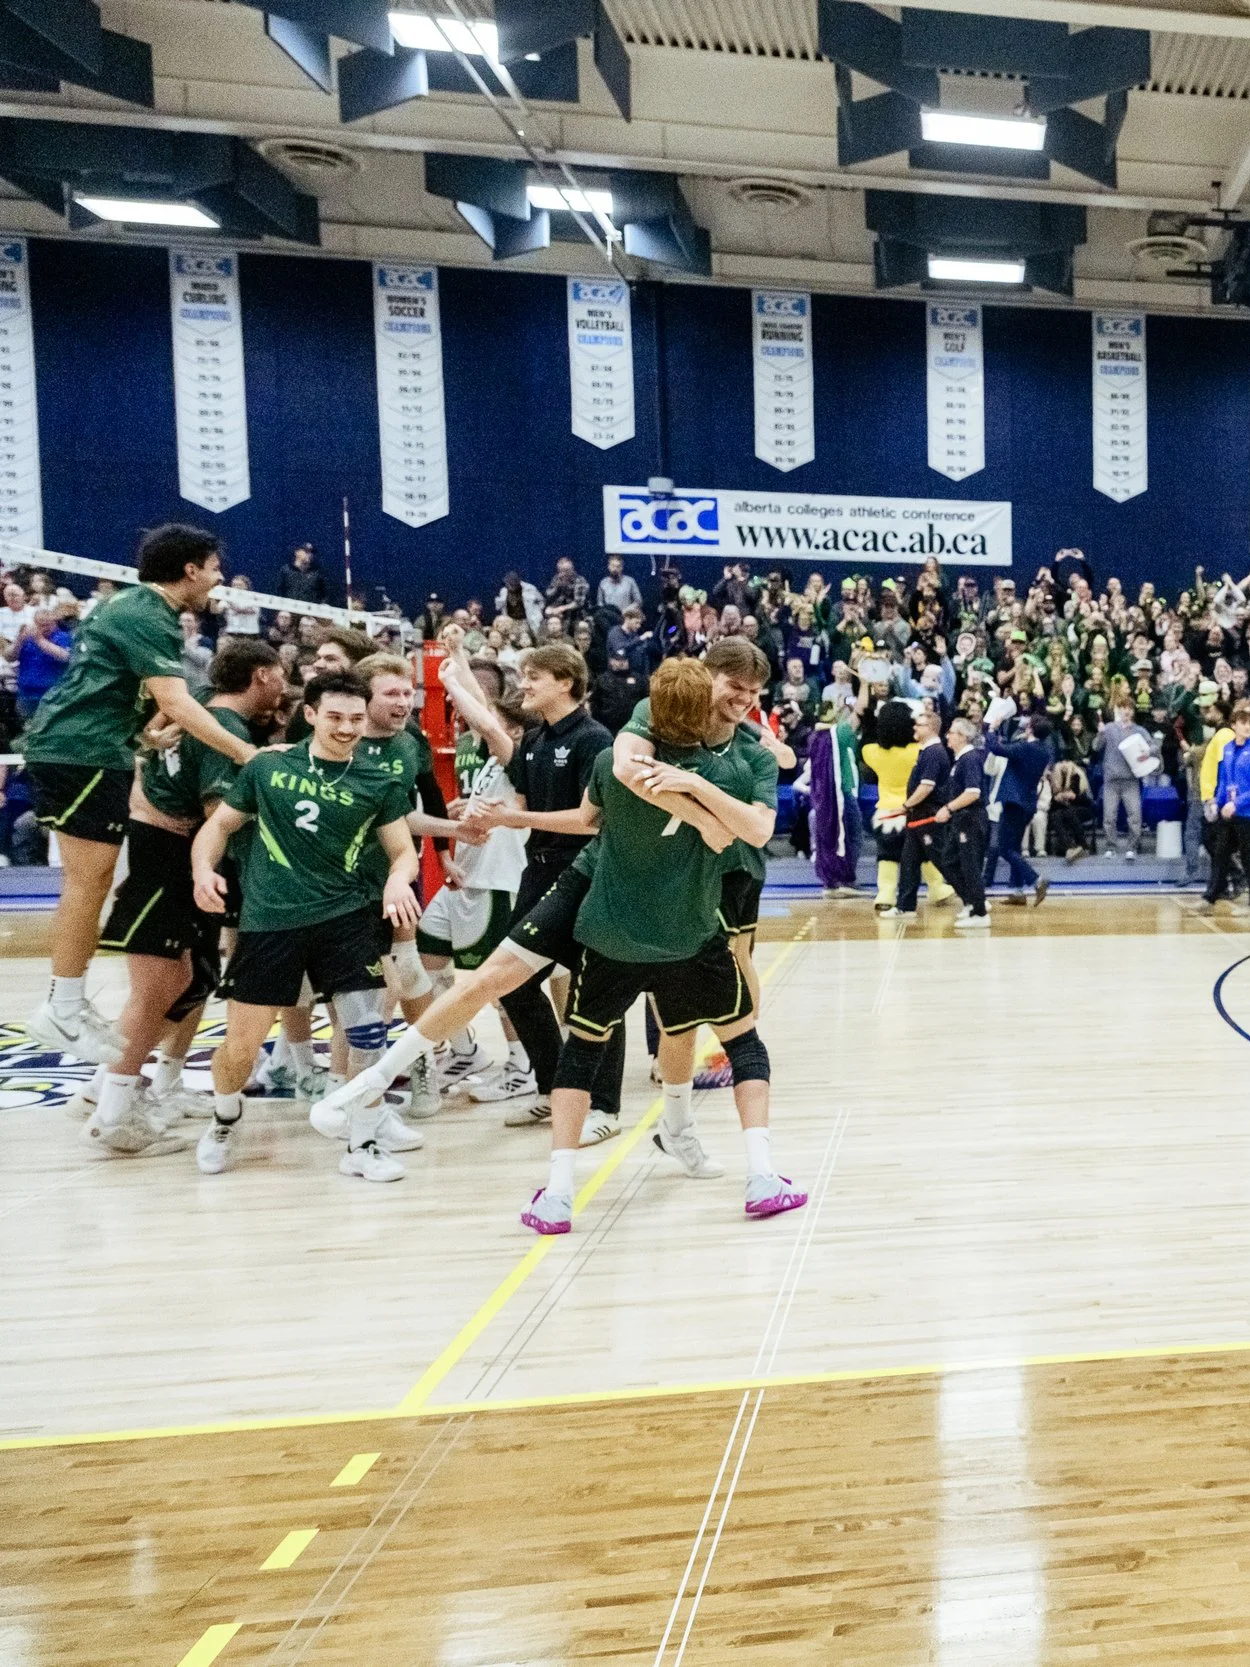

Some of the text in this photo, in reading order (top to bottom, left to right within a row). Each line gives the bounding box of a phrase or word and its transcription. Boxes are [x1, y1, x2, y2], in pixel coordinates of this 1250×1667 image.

[386, 295, 427, 305] WOMEN'S
[388, 306, 425, 318] SOCCER
[587, 310, 612, 318] MEN'S
[384, 322, 431, 334] CHAMPIONS
[575, 319, 625, 332] VOLLEYBALL
[577, 334, 624, 346] CHAMPIONS
[761, 330, 803, 342] RUNNING
[943, 332, 966, 341] MEN'S
[944, 341, 965, 352] GOLF
[1108, 341, 1130, 350] MEN'S
[761, 346, 804, 358] CHAMPIONS
[1097, 351, 1142, 362] BASKETBALL
[734, 501, 975, 522] alberta colleges athletic conference
[618, 498, 720, 543] acac
[735, 523, 988, 556] www.acac.ab.ca
[270, 771, 354, 806] KINGS
[294, 800, 320, 833] 2
